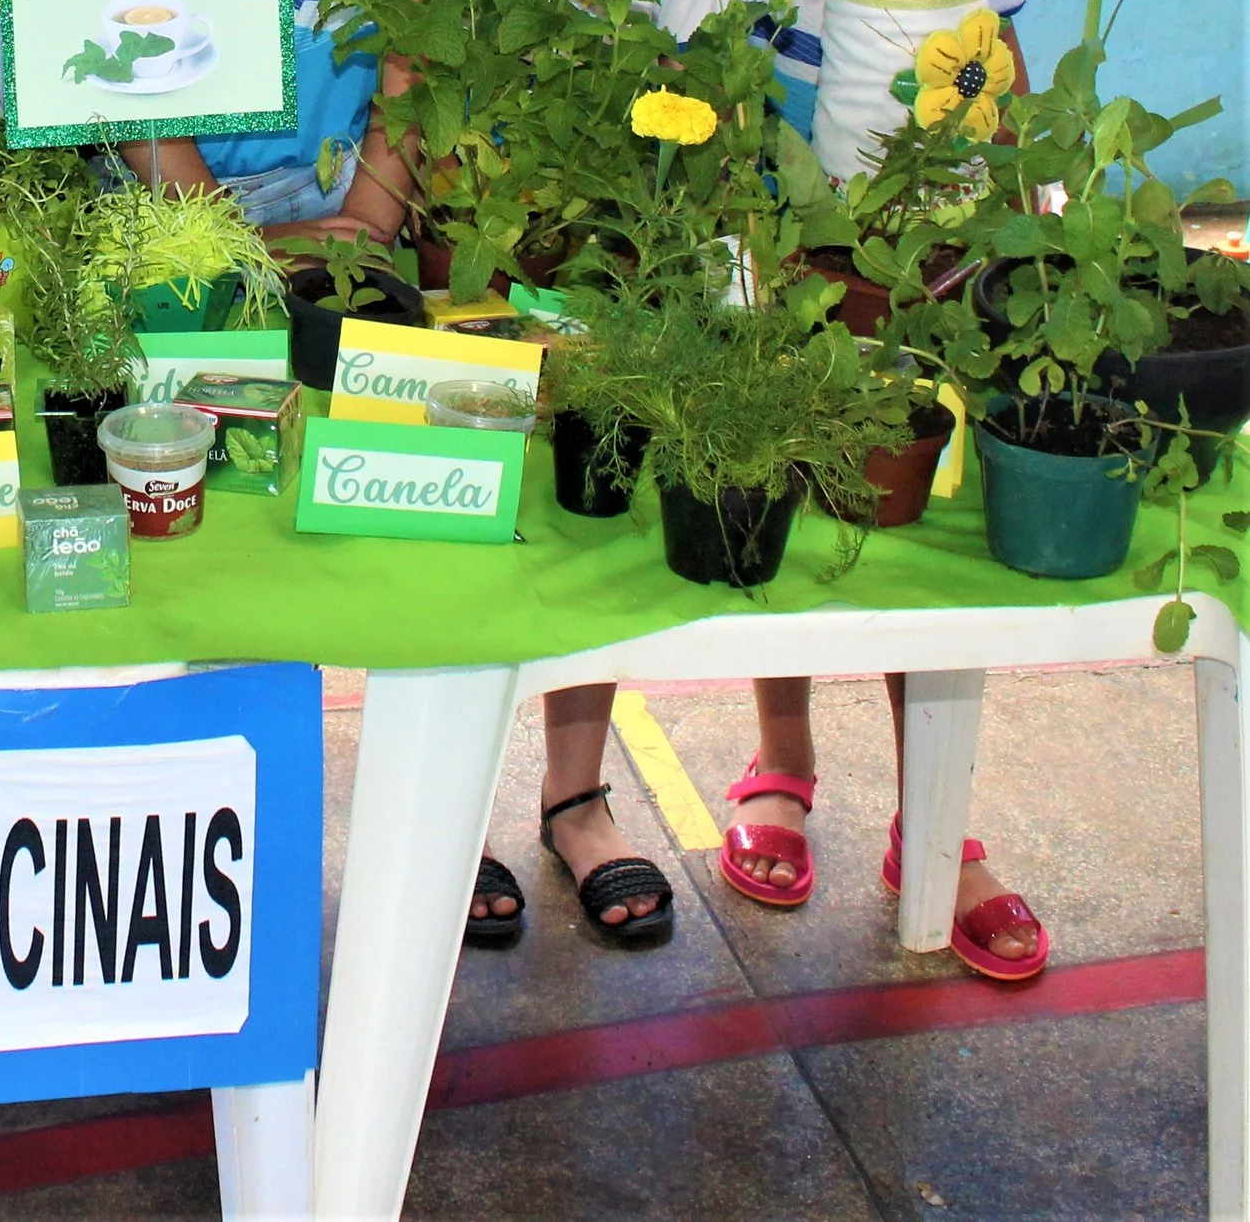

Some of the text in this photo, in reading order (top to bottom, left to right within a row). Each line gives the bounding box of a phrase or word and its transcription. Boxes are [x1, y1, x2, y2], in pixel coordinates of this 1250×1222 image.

[148, 482, 176, 493] Seven
[322, 455, 492, 509] Canela
[124, 494, 198, 514] ERVA DOCE
